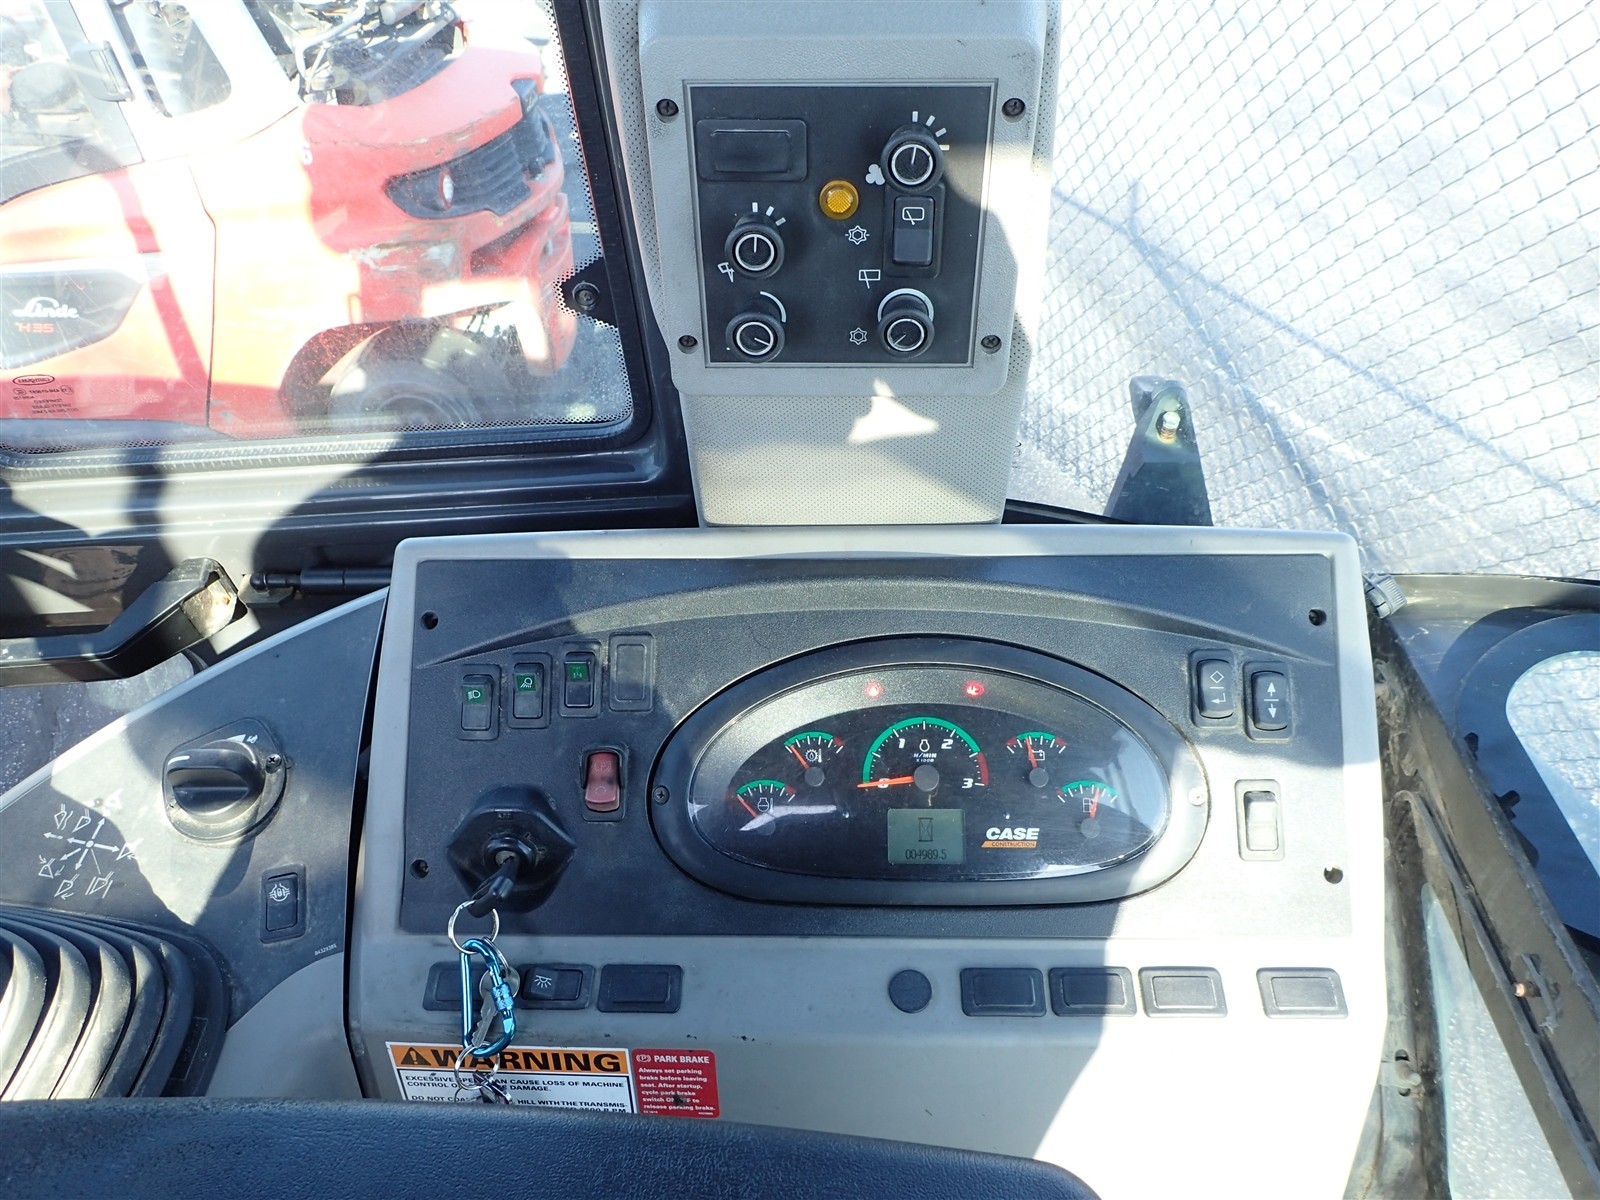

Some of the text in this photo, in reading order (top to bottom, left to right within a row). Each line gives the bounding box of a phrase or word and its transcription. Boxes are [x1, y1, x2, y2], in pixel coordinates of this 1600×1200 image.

[12, 296, 79, 318] Linde
[898, 738, 906, 749] 1
[941, 738, 954, 749] 2
[961, 777, 974, 789] 3
[986, 827, 1040, 841] CASE
[430, 1049, 621, 1072] WARNING
[653, 1055, 678, 1063] PARK
[680, 1055, 710, 1064] BRAKE
[405, 1075, 454, 1083] EXCESSIVE
